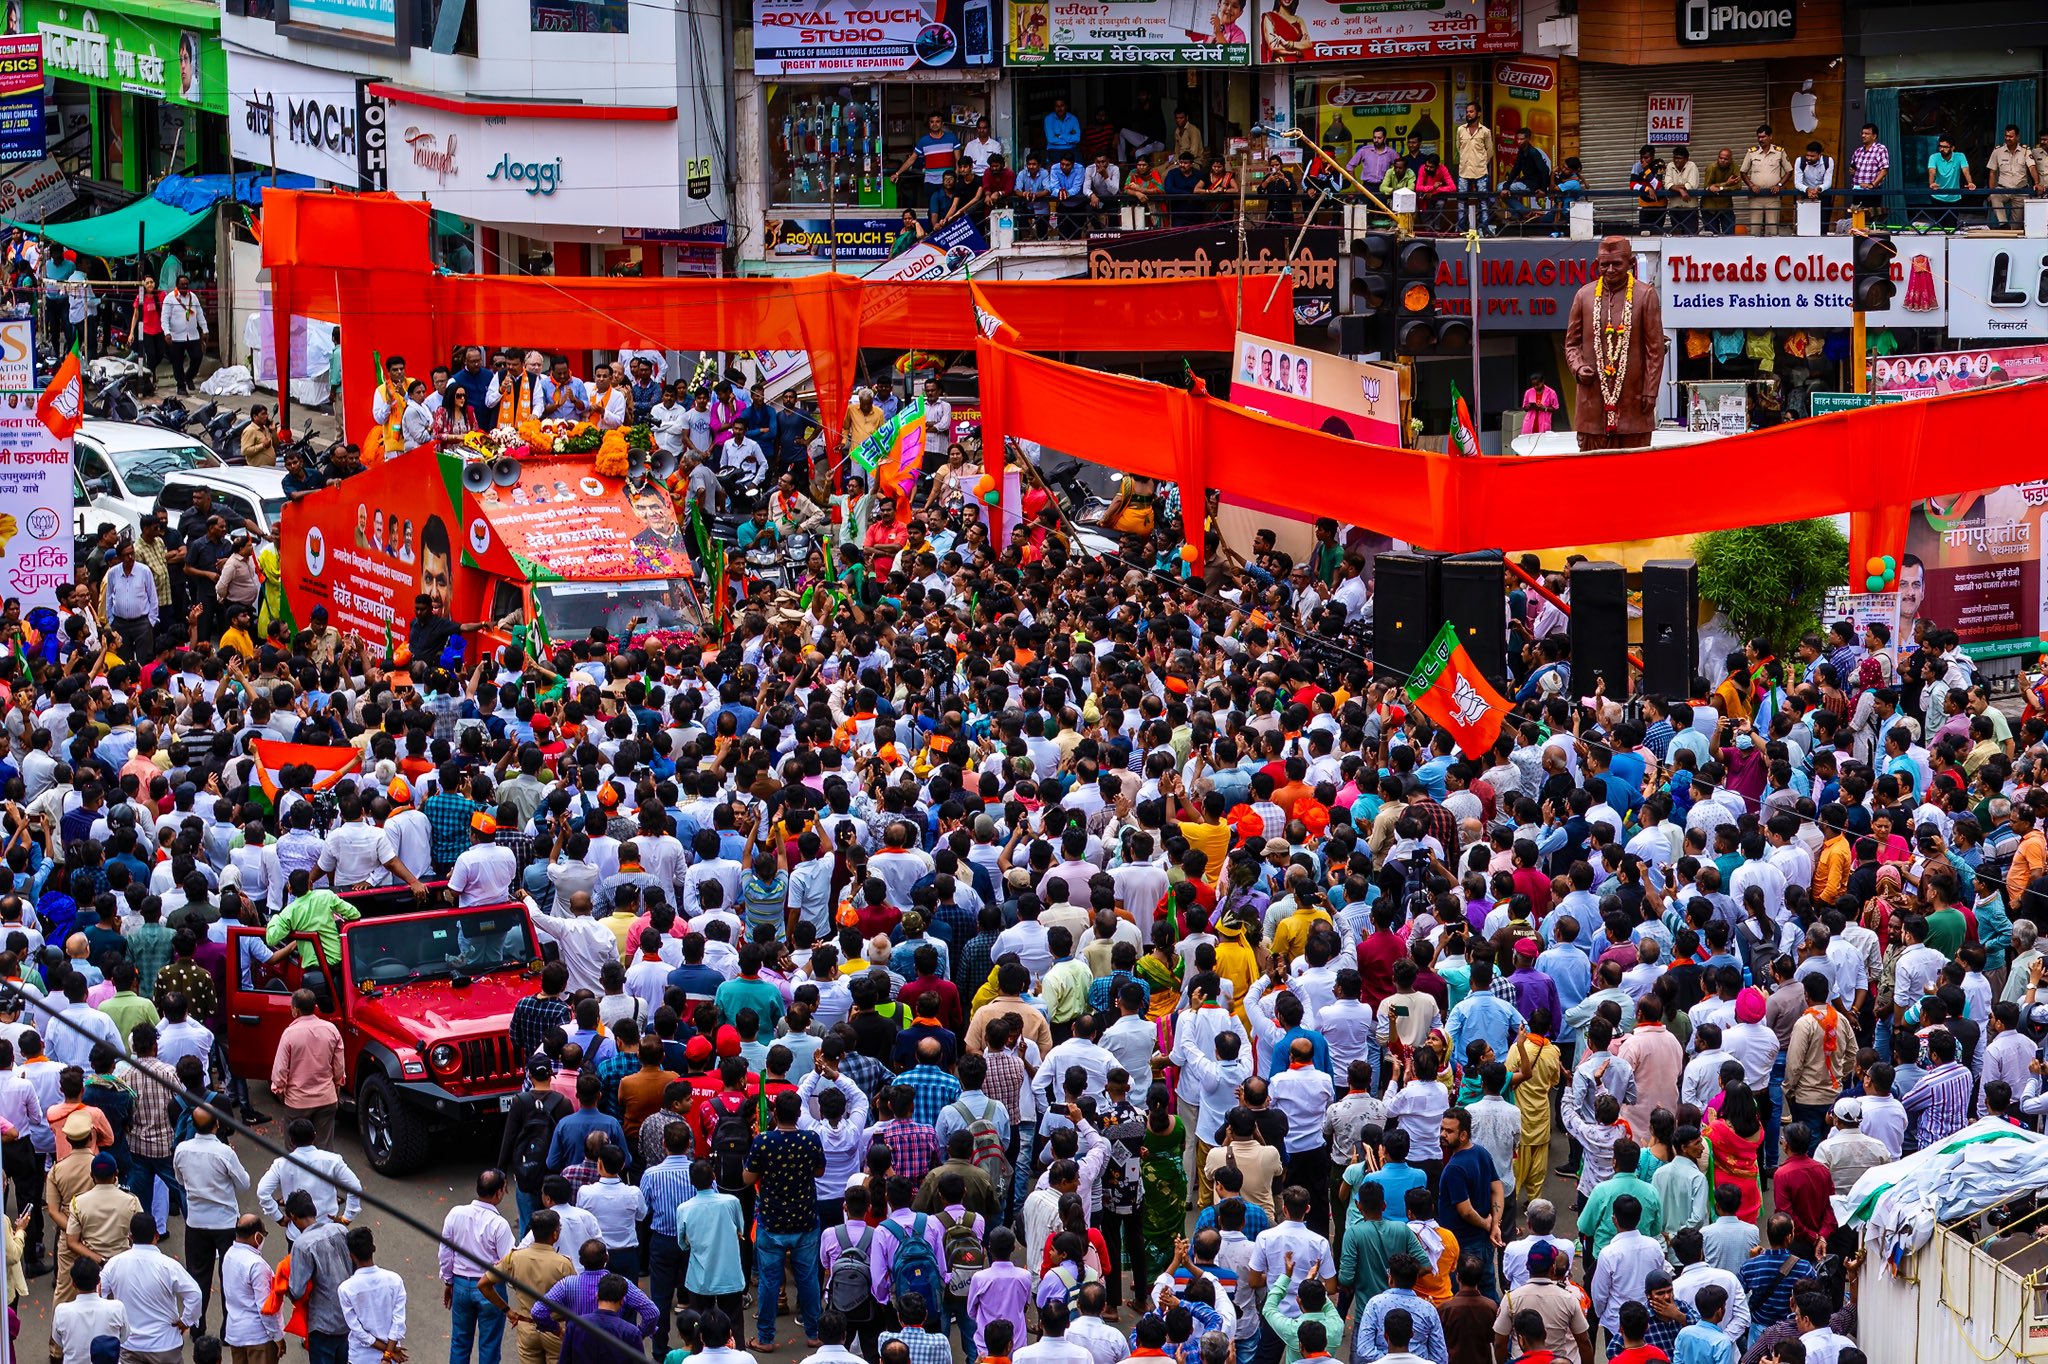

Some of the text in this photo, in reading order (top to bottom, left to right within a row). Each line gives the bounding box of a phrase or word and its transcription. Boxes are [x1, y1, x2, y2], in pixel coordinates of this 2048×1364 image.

[761, 8, 921, 28] ROYAL TOUCH
[1710, 5, 1793, 31] iPhone
[799, 27, 885, 44] STUDIO
[1089, 27, 1147, 42] शंखपुष्पी
[775, 46, 910, 58] ALL TYPES OF BRANDED MOBILE ACCESSORIES
[1053, 43, 1224, 62] विजय मेडीकल स्टोर्स
[1313, 34, 1478, 58] विजय मेडीकल स्टोर्स
[780, 57, 905, 71] URGENT MOBILE REPAIRING
[1498, 65, 1550, 86] बैद्यनाथ
[1332, 87, 1431, 105] बैद्यनाथ
[1649, 97, 1690, 113] RENT/
[1651, 116, 1684, 130] SALE
[0, 149, 43, 161] 60016328
[486, 152, 564, 197] sloggi
[785, 232, 833, 245] ROYAL
[833, 232, 882, 245] TOUCH
[824, 247, 890, 256] UGENT MOBILE
[1433, 258, 1469, 287] AL
[1667, 253, 1905, 284] Threads Collecn
[1487, 298, 1524, 317] PVT.
[1529, 298, 1558, 317] LTD
[1672, 293, 1854, 309] Ladies Fashion & Stitc
[14, 447, 69, 465] फडणवीस
[1943, 518, 2032, 553] नागपूरातील
[18, 546, 69, 574] हार्दिक
[1974, 582, 1983, 591] 10
[1410, 638, 1451, 690] BJP
